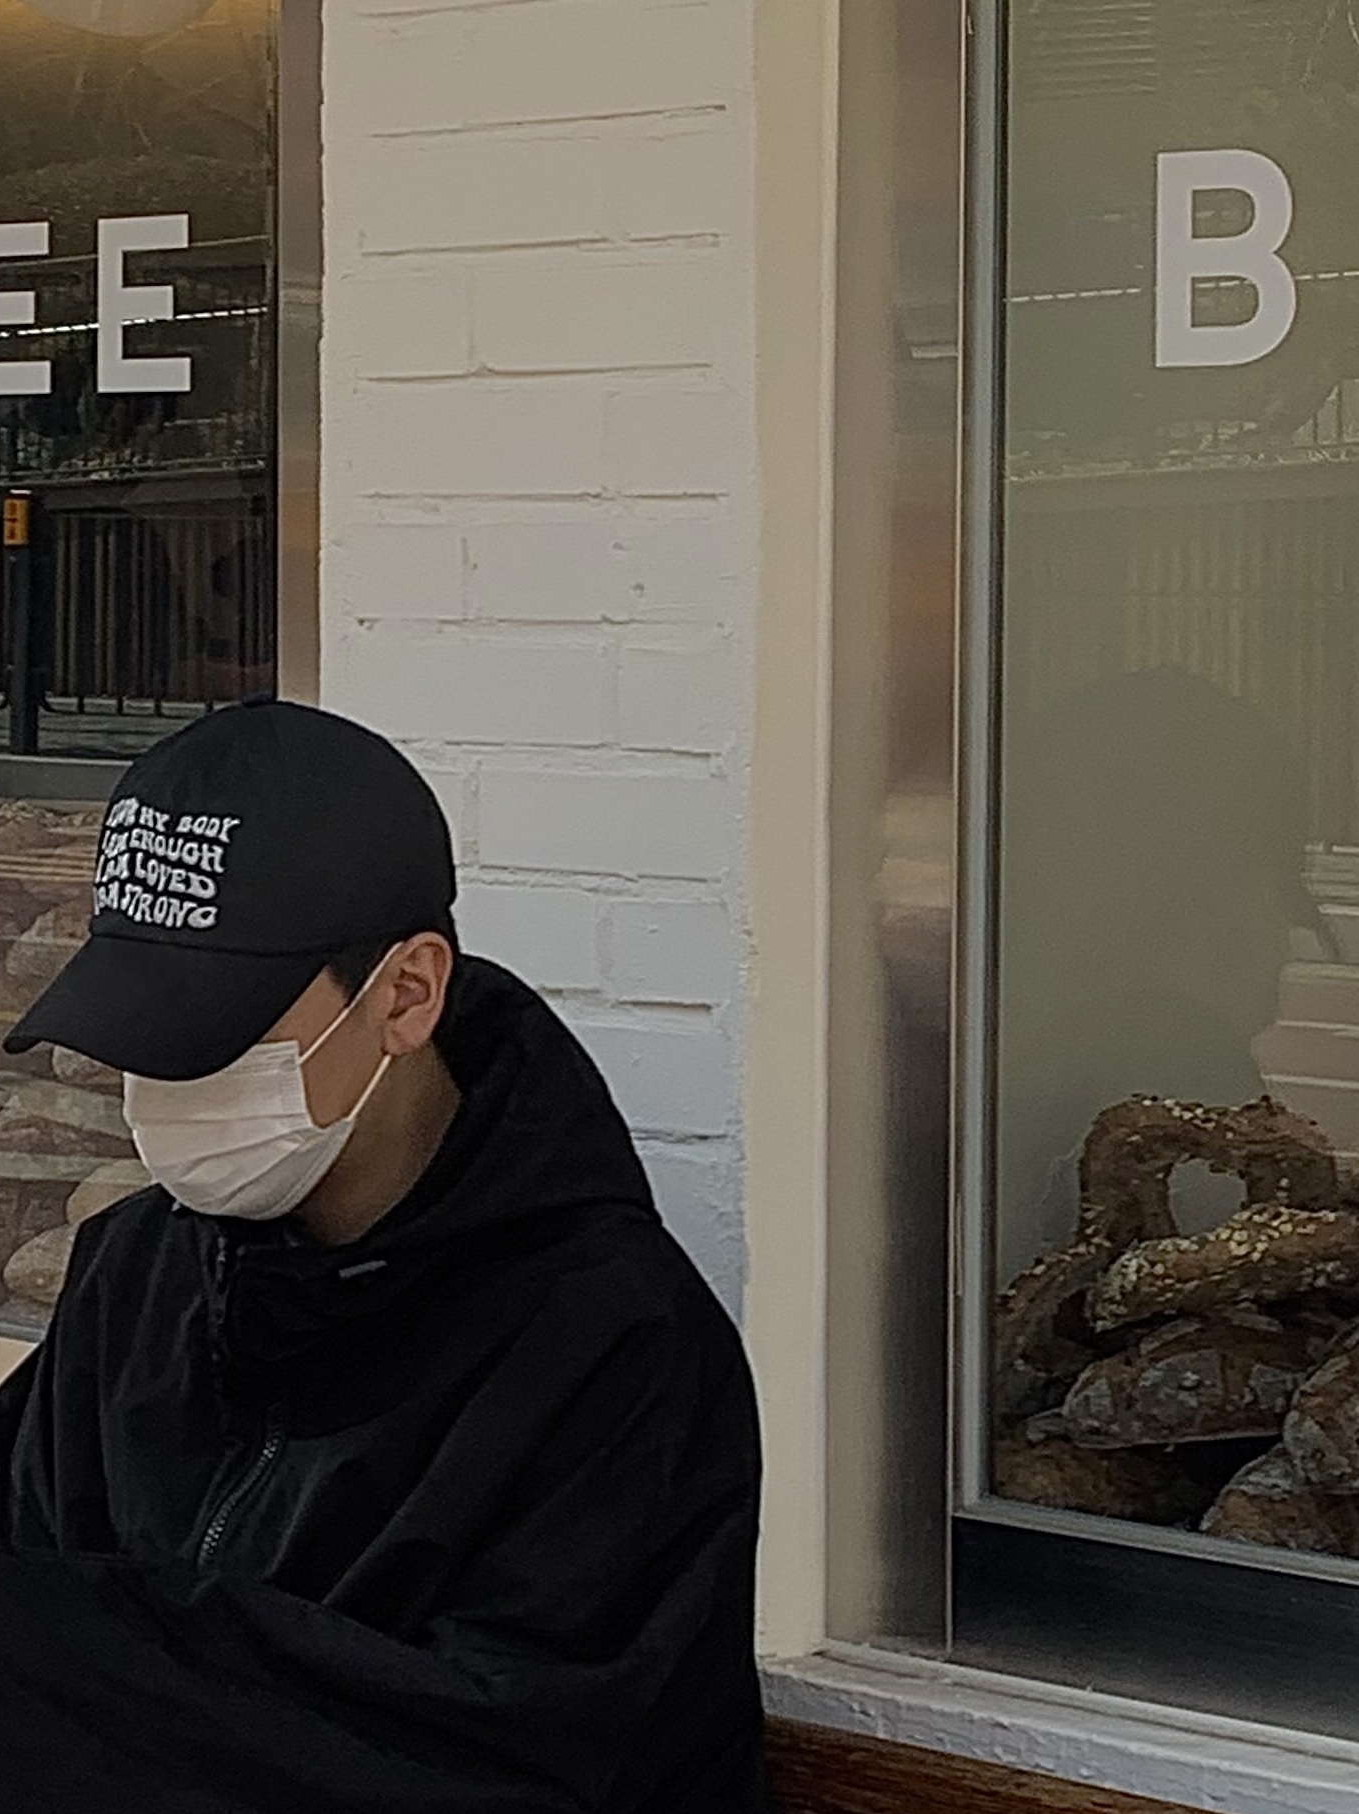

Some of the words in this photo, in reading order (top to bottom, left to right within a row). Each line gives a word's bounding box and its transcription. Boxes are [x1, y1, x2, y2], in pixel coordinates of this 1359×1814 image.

[1156, 149, 1296, 367] B
[129, 828, 224, 873] ENOUGH
[176, 815, 241, 843] BODY
[134, 852, 217, 899] LOVED
[120, 883, 218, 928] STRONG
